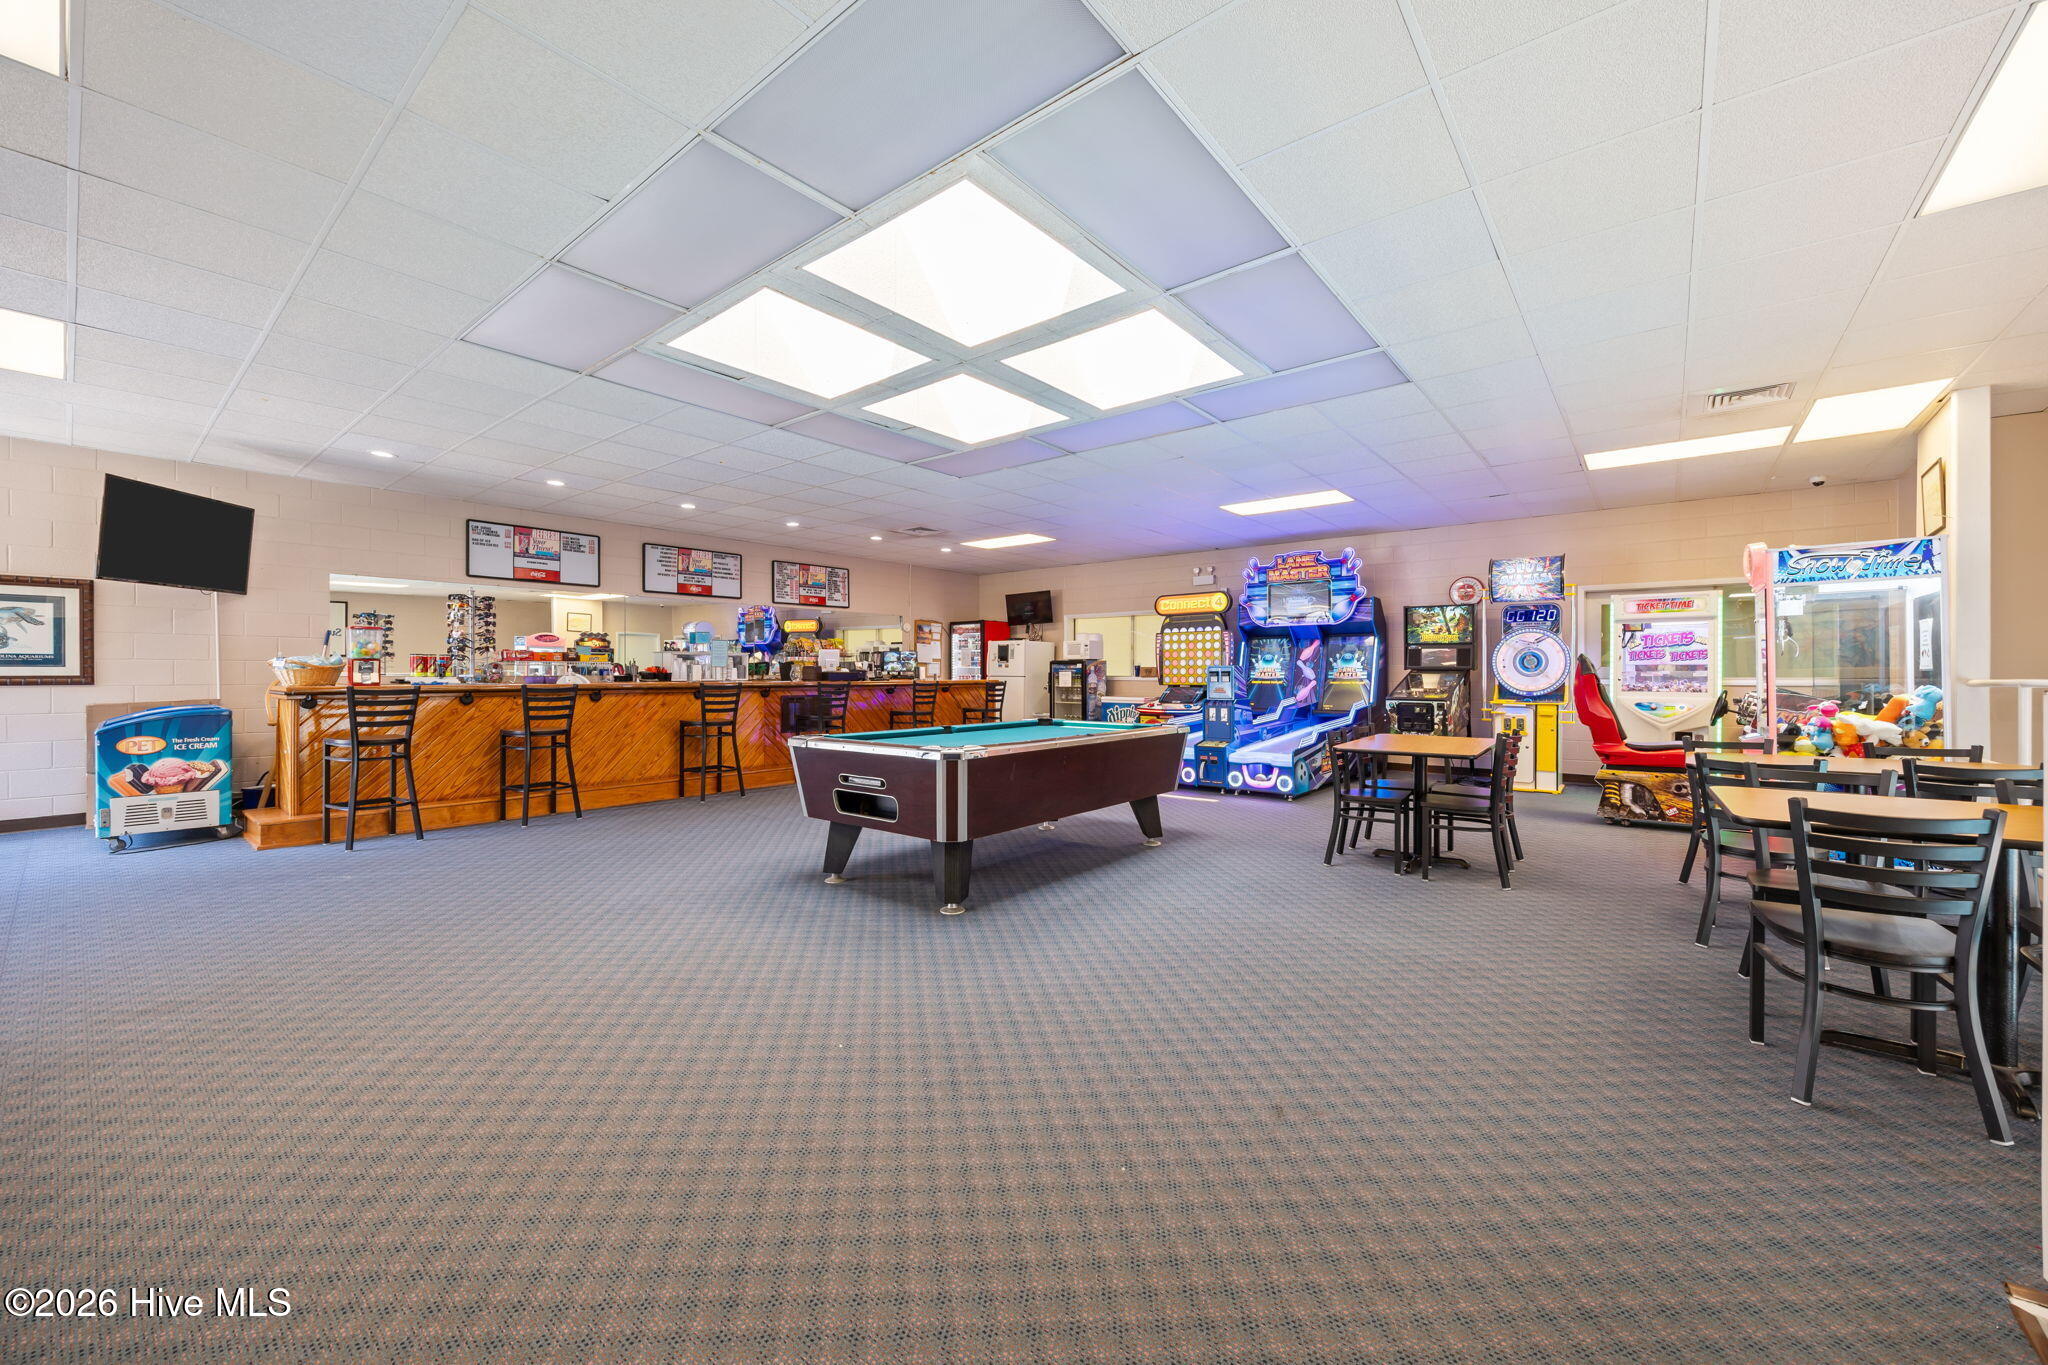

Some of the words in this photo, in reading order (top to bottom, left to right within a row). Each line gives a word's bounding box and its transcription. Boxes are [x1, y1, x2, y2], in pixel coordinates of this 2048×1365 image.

[1277, 554, 1317, 569] LANE
[1860, 549, 1922, 571] Time
[1267, 565, 1329, 582] MASTER
[1160, 598, 1212, 610] Connect
[1636, 601, 1669, 610] TICKET
[1669, 600, 1695, 609] TIME
[1640, 631, 1695, 648] TICKETS
[1629, 649, 1667, 661] TICKETS
[1670, 649, 1708, 662] TICKETS
[124, 740, 158, 753] PET
[189, 742, 218, 750] CREAM
